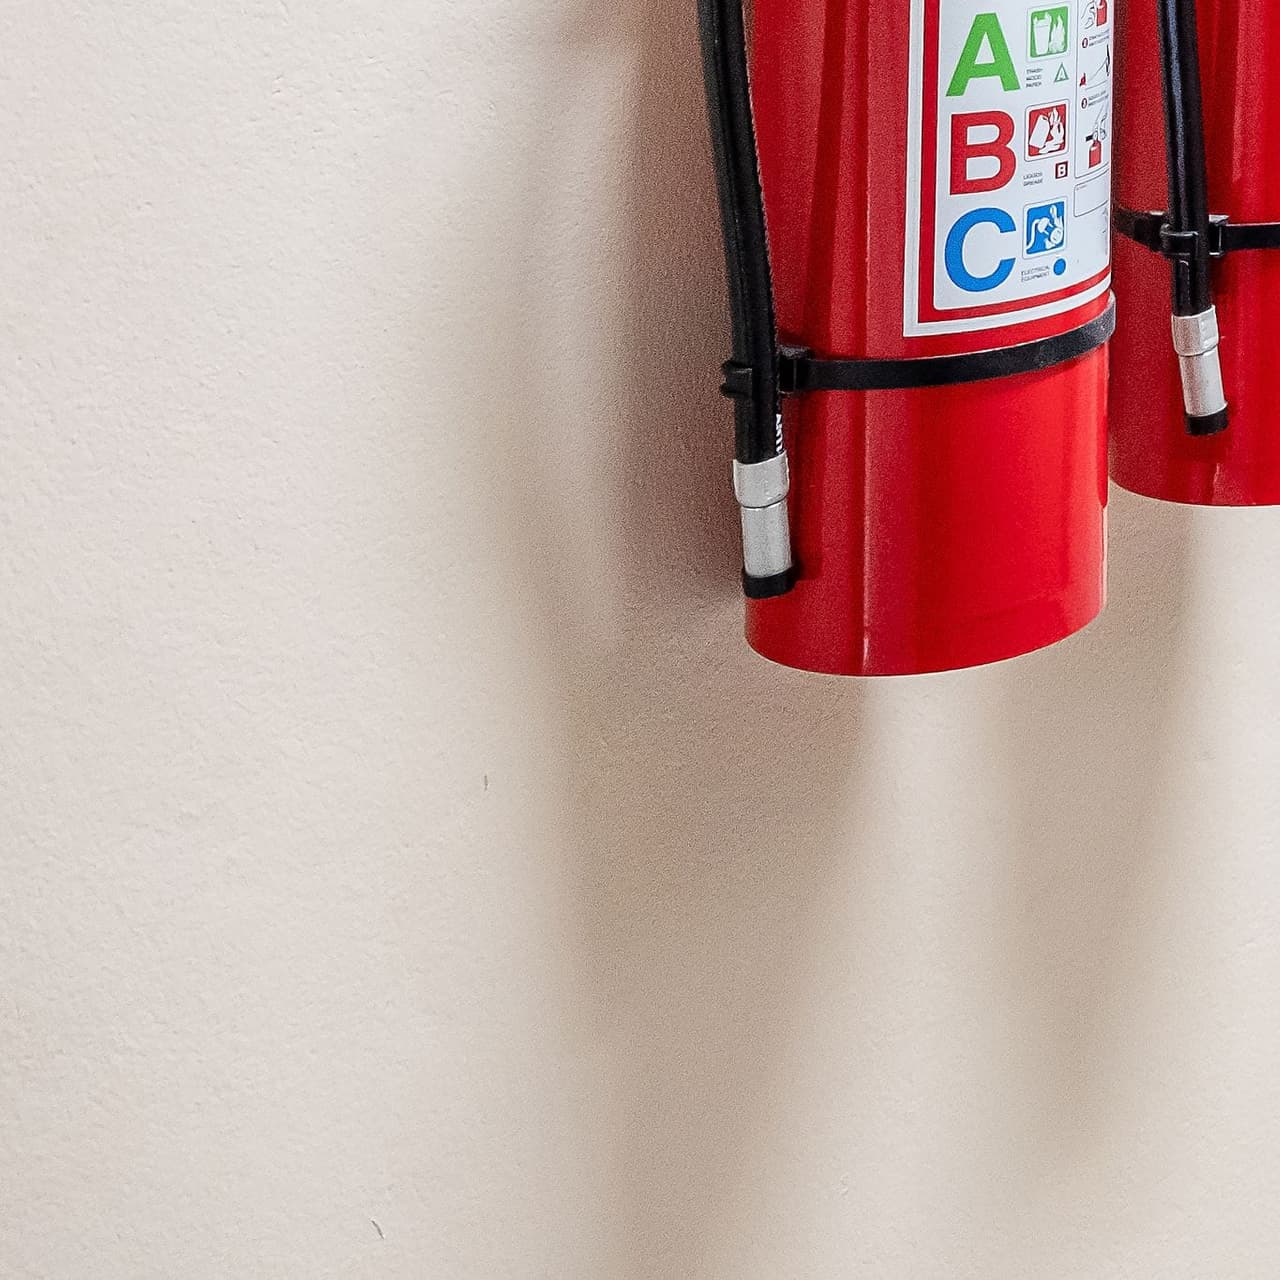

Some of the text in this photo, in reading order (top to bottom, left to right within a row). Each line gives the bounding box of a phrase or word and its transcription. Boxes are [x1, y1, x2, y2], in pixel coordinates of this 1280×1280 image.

[946, 12, 1020, 97] A
[950, 111, 1017, 196] B
[944, 206, 1017, 293] C
